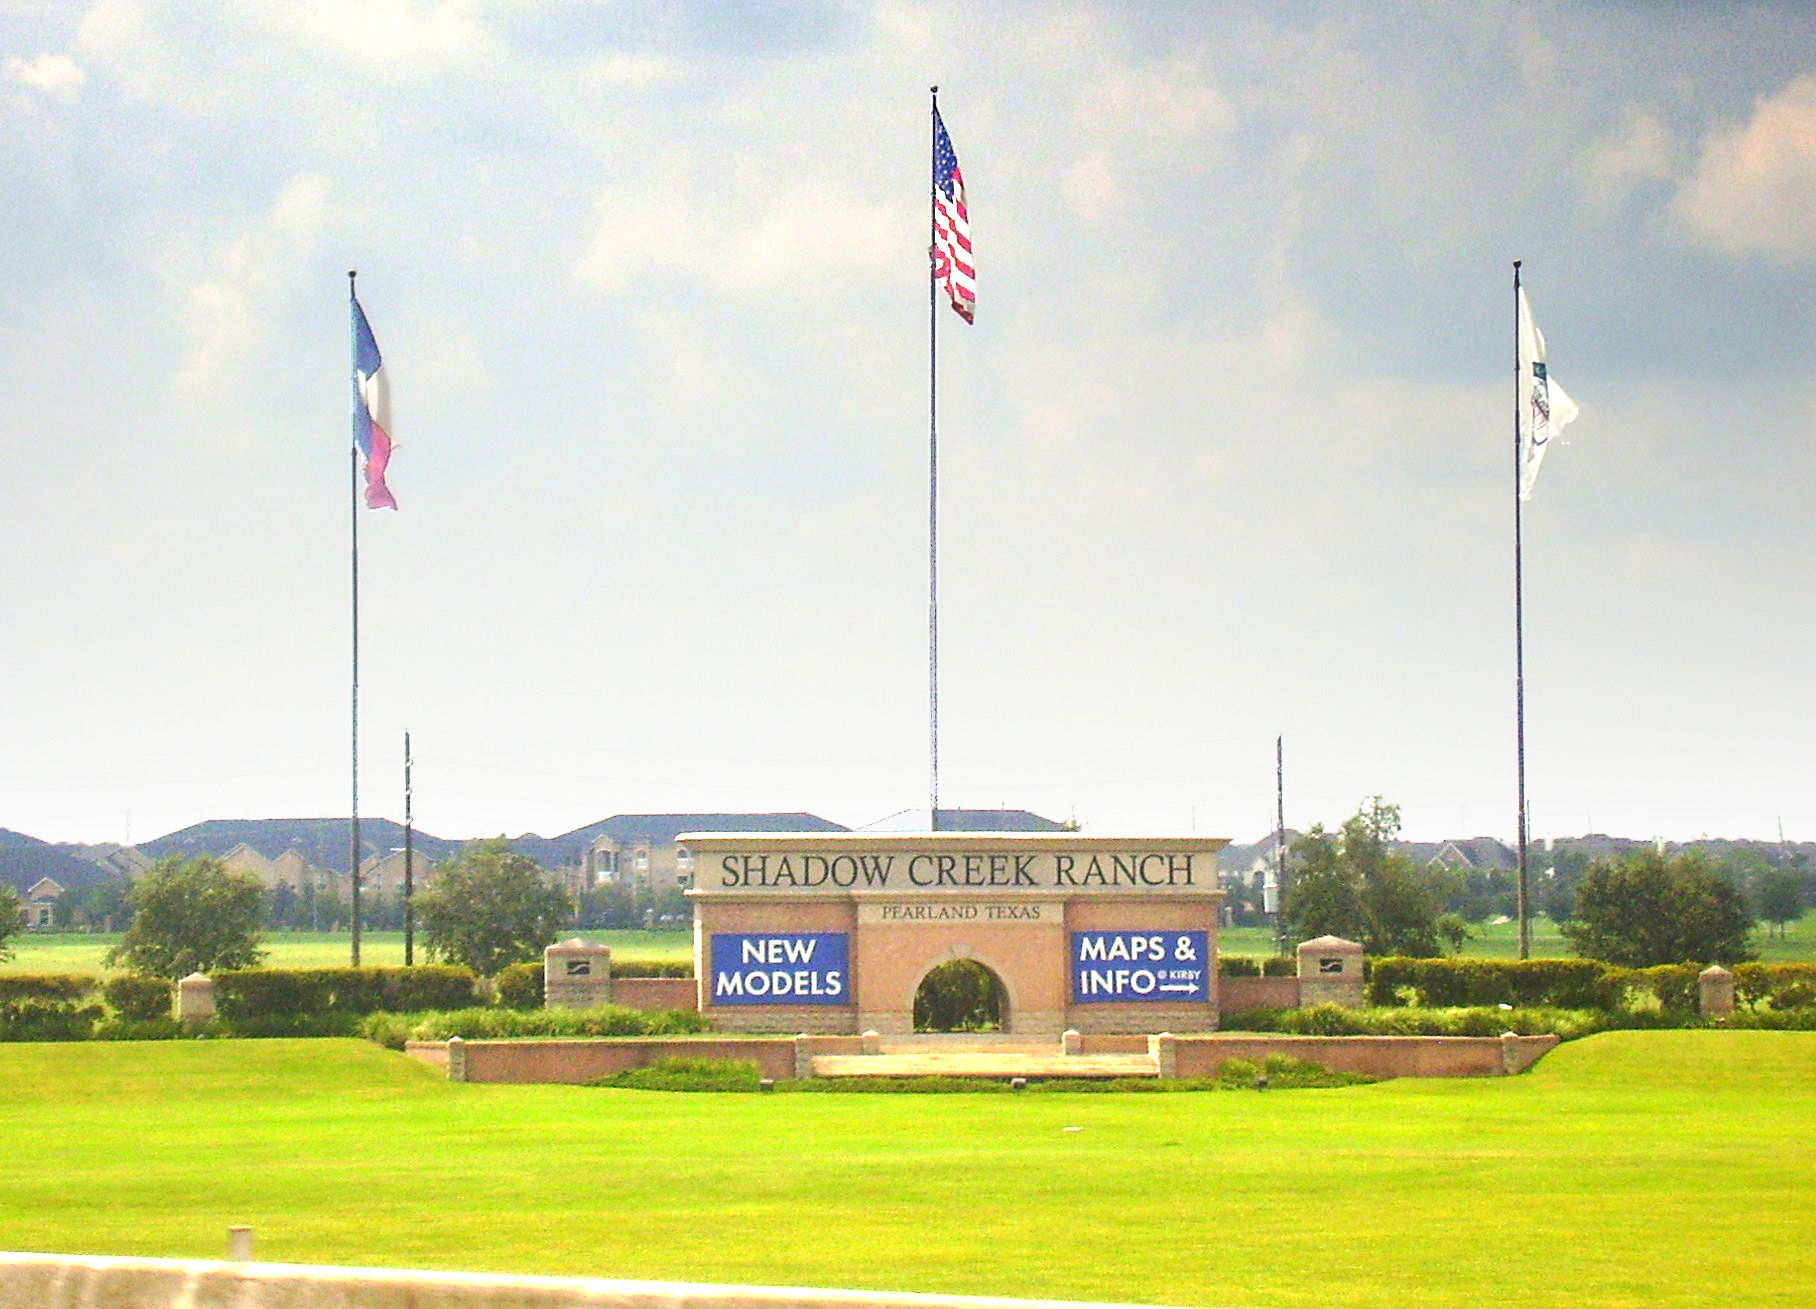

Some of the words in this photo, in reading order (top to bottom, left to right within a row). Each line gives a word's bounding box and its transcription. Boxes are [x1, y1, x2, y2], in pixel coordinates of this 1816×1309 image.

[722, 856, 895, 887] SHADOW
[908, 856, 1038, 886] CREEK
[1055, 854, 1195, 886] RANCH
[882, 907, 978, 920] PEARLAND
[985, 907, 1040, 920] TEXAS
[742, 940, 816, 965] NEW
[1080, 937, 1164, 961] MAPS
[1174, 936, 1196, 960] &
[716, 972, 841, 996] MODELS
[1081, 970, 1155, 994] INFO
[1170, 970, 1200, 980] KIRBY
